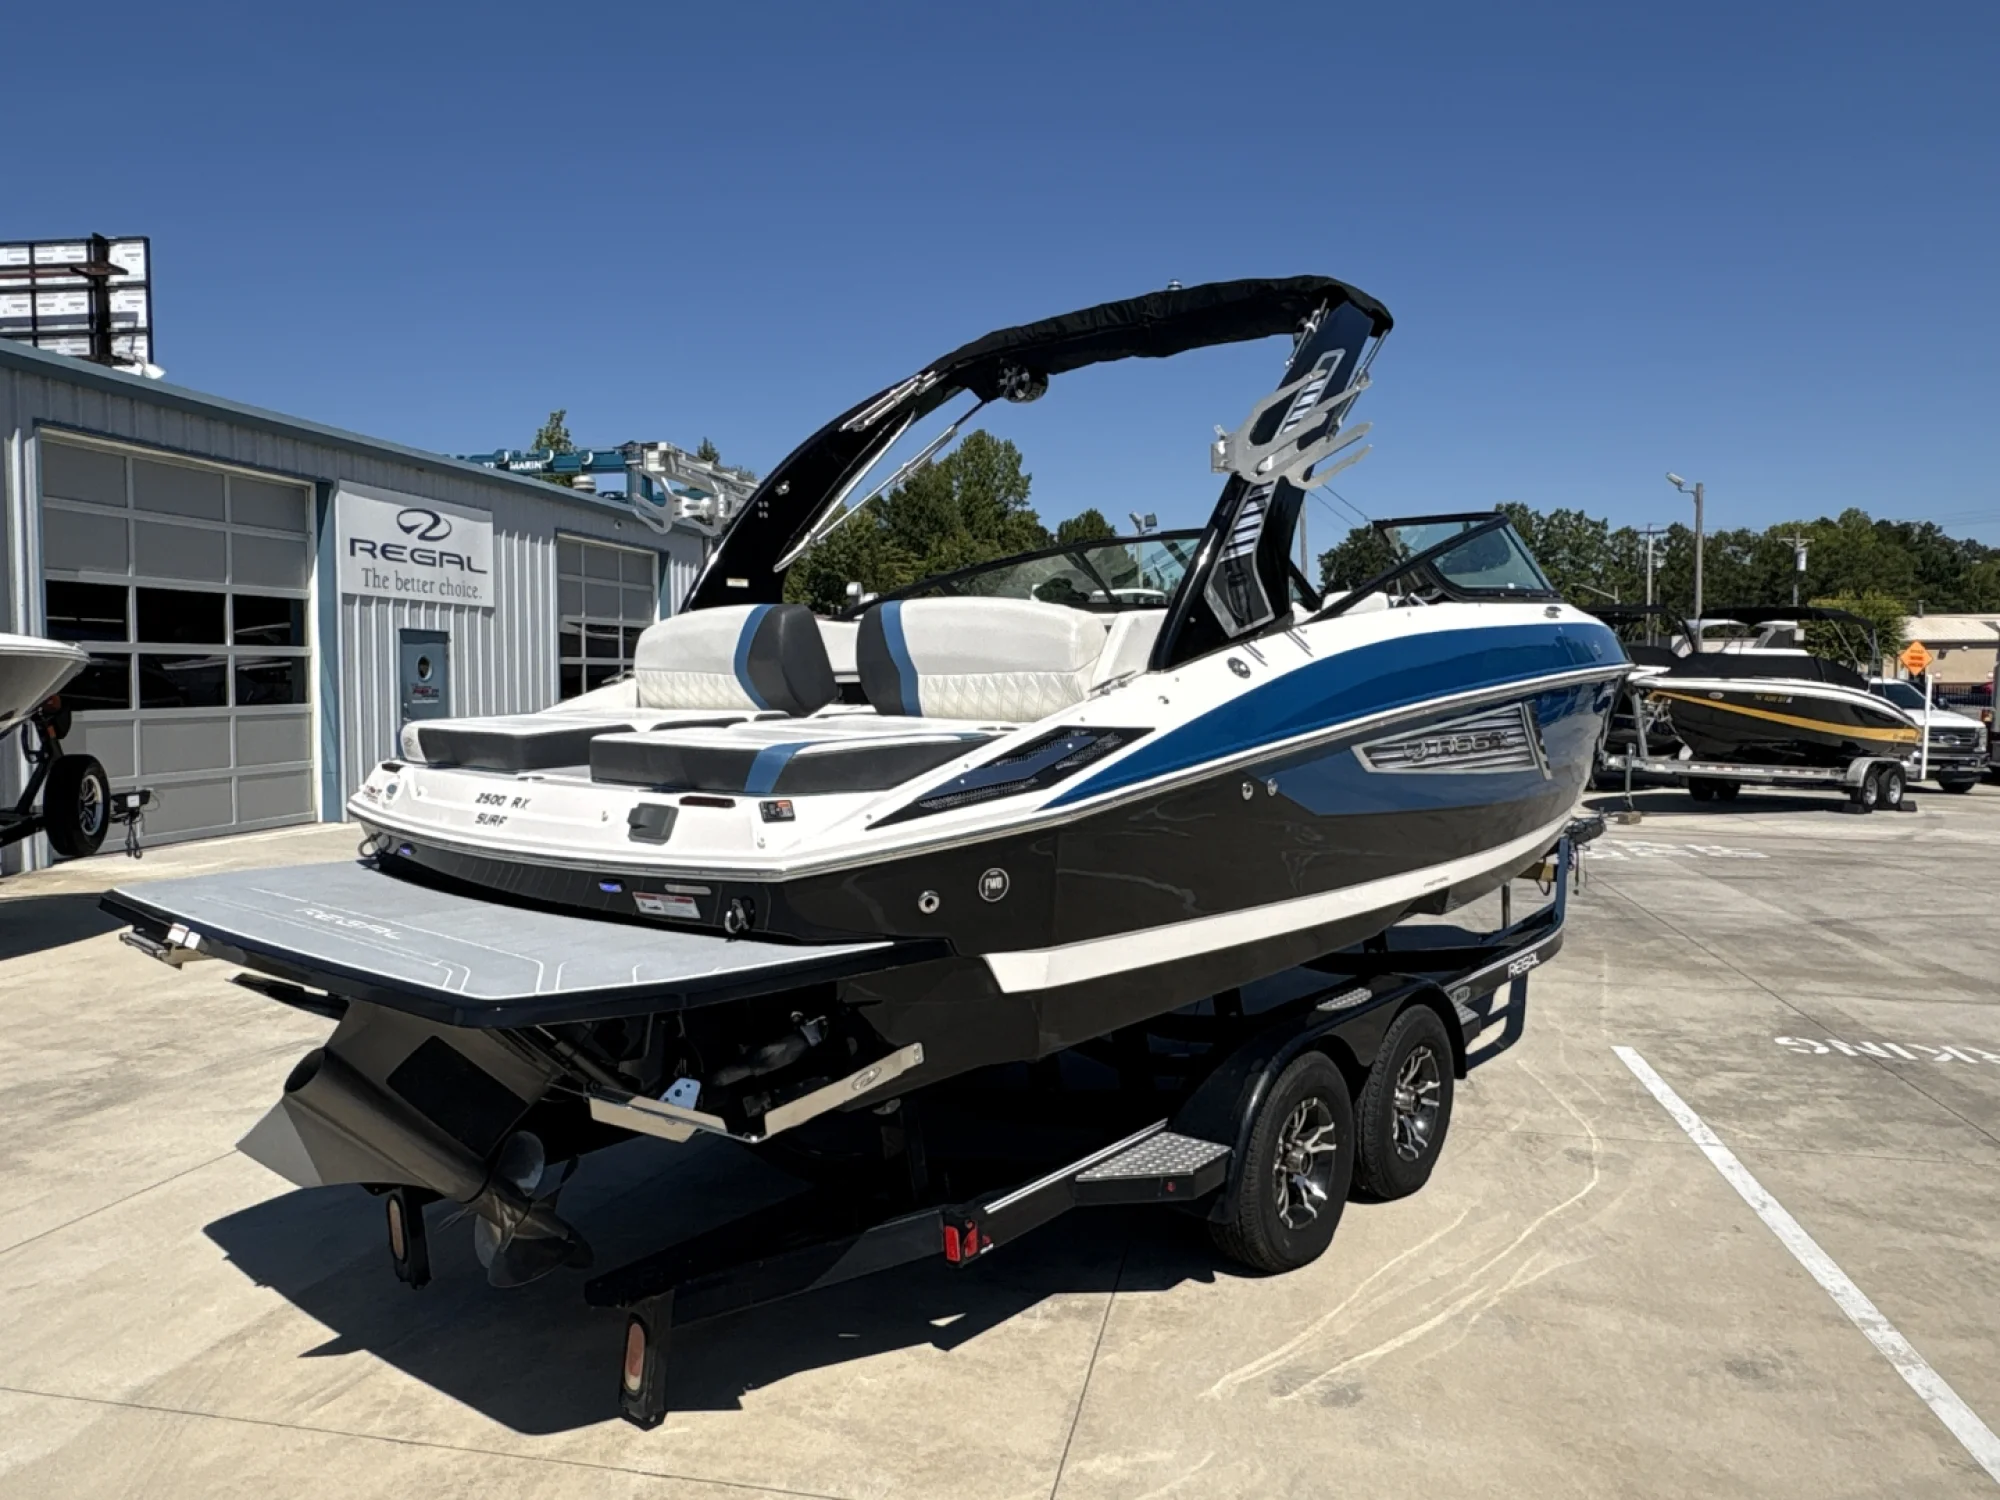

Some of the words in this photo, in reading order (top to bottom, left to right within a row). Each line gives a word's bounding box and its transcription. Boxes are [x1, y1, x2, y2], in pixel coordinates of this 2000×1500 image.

[509, 460, 547, 470] MARIN
[349, 537, 488, 575] REGAL
[361, 567, 390, 590] The
[394, 569, 436, 594] better
[438, 576, 483, 600] choice.
[475, 792, 508, 807] 2500
[510, 796, 532, 810] RX
[475, 812, 508, 828] SURF
[1508, 951, 1540, 979] REGAL
